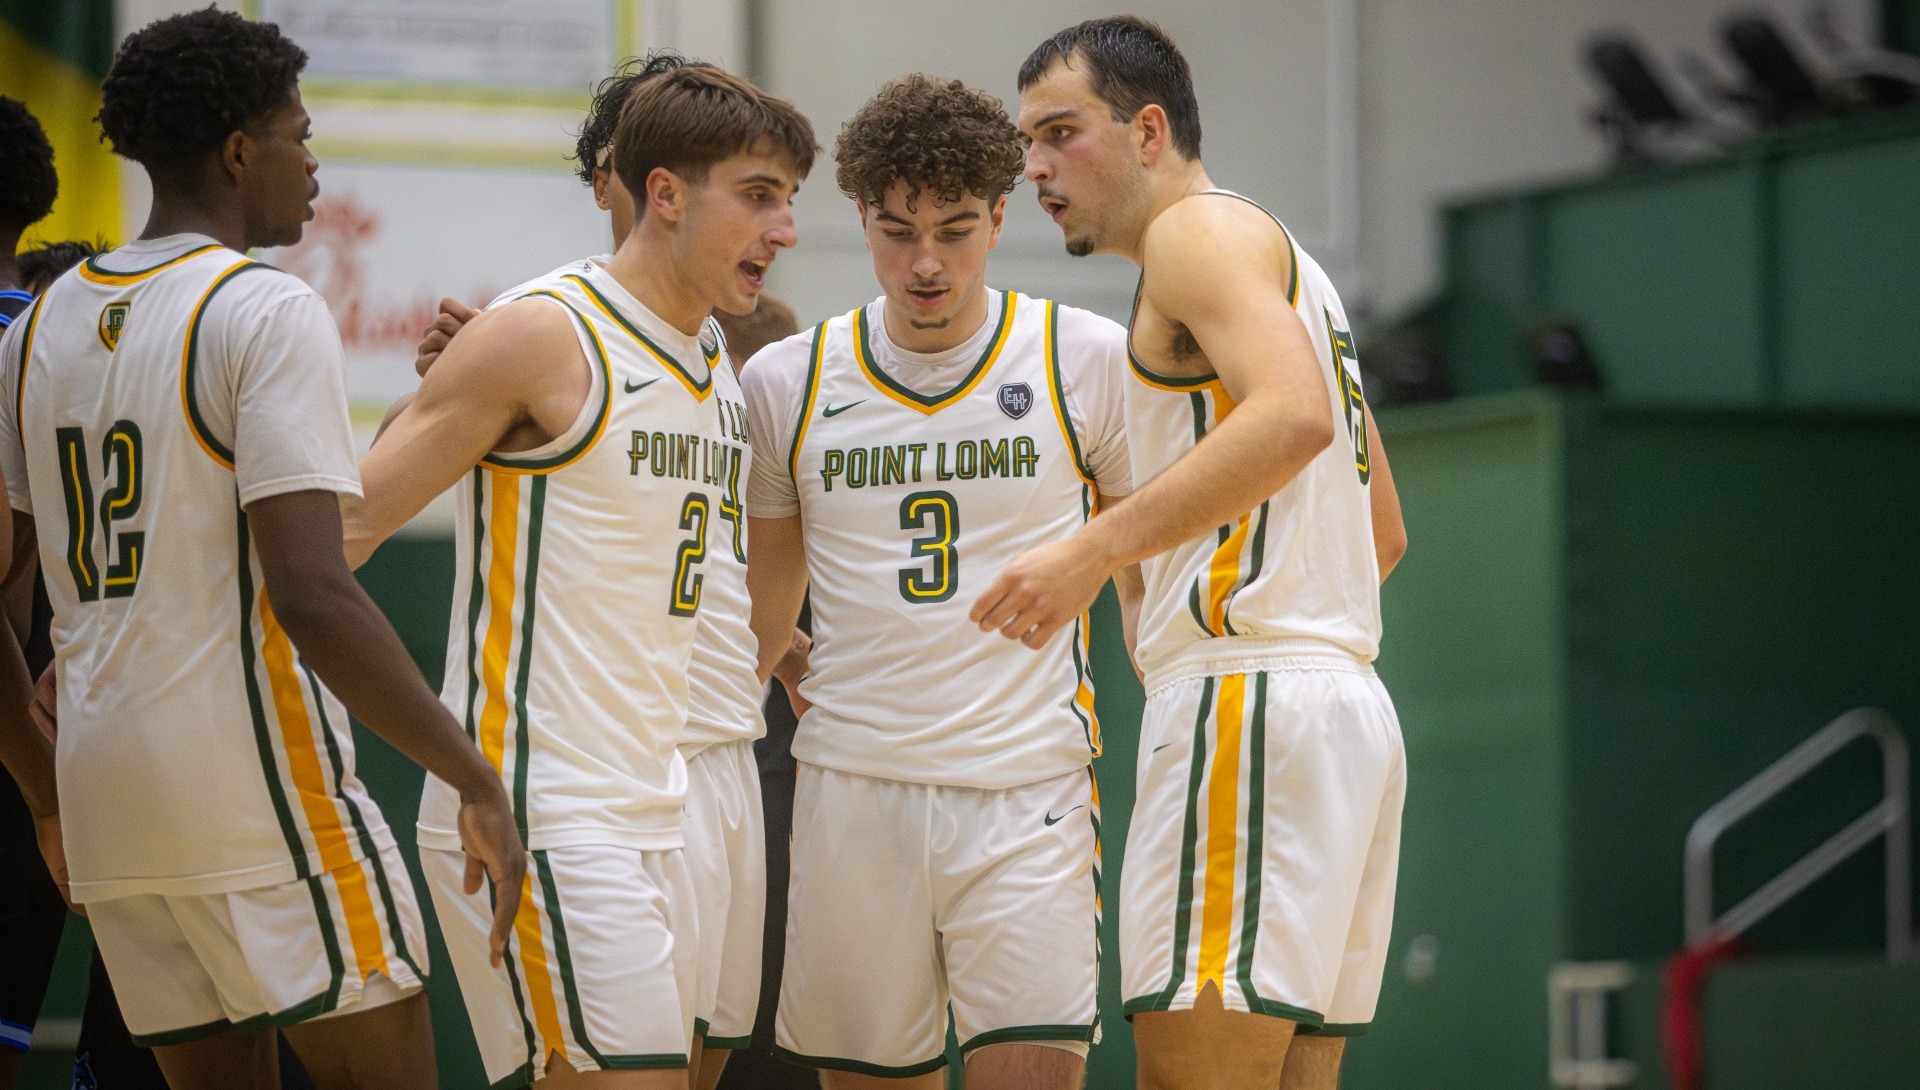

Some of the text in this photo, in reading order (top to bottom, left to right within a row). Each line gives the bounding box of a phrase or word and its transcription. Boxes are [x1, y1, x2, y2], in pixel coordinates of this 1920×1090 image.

[56, 419, 145, 602] 12
[627, 429, 699, 481] POINT
[820, 435, 1040, 492] POINT LOMA
[668, 492, 710, 618] 2
[898, 490, 960, 604] 3
